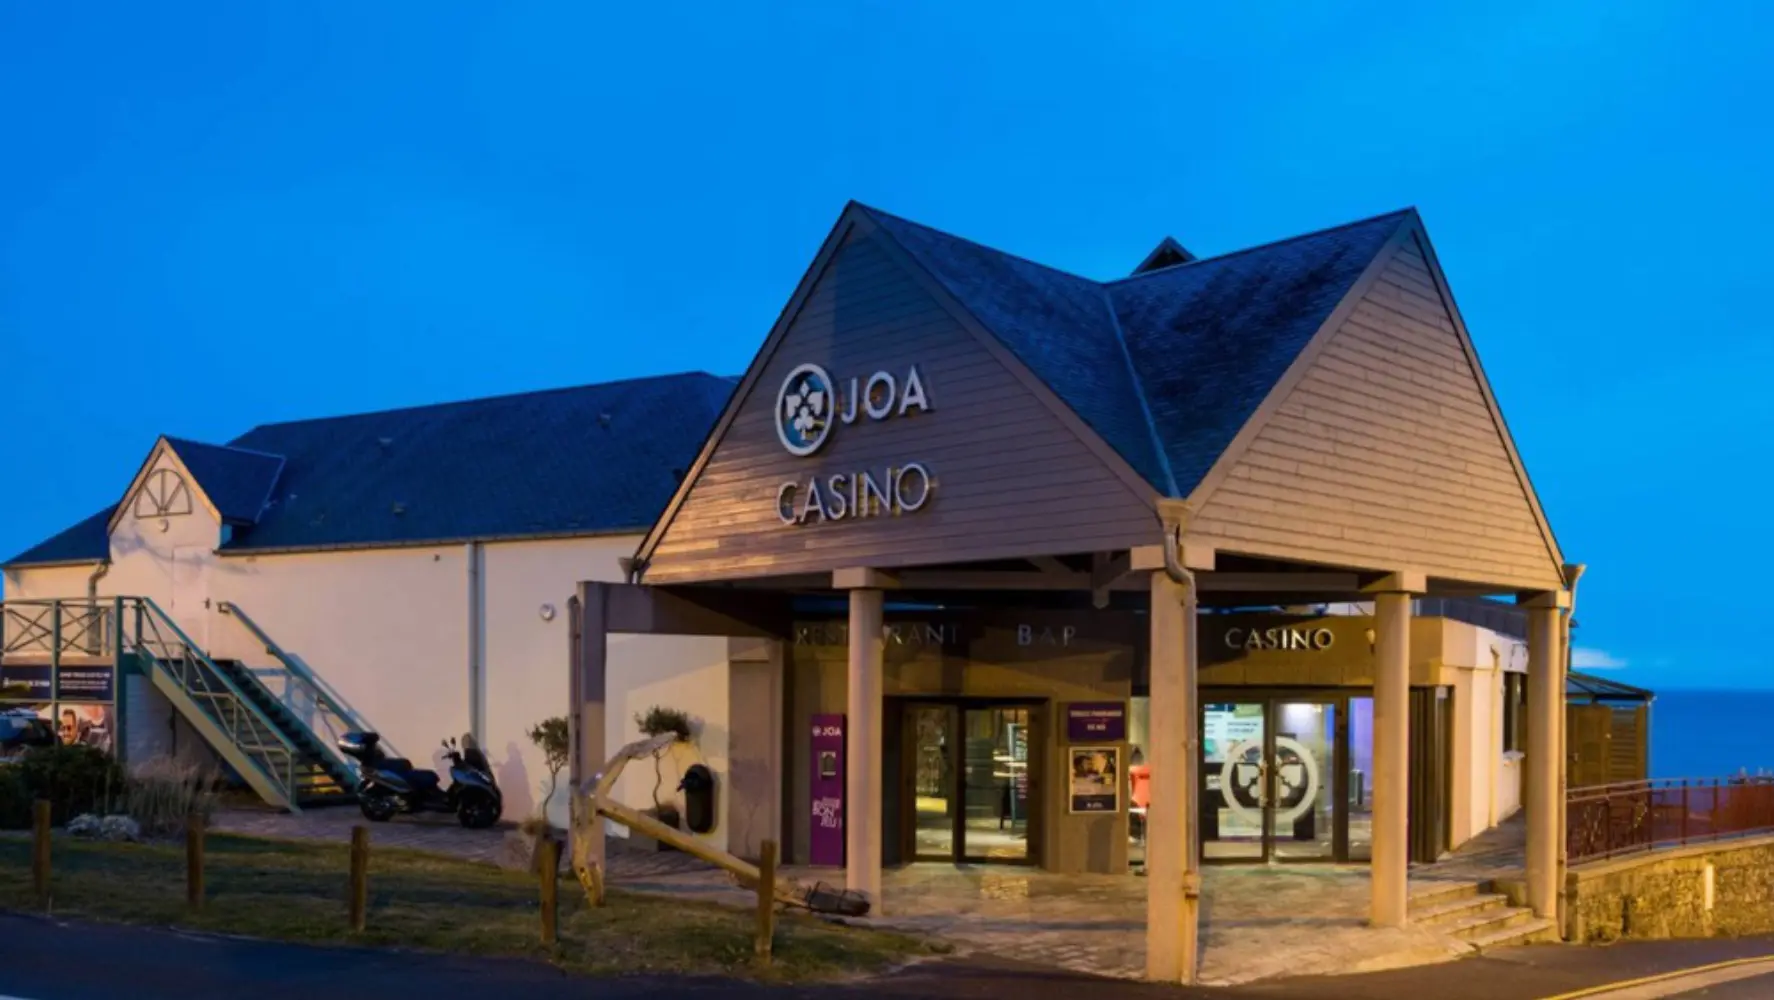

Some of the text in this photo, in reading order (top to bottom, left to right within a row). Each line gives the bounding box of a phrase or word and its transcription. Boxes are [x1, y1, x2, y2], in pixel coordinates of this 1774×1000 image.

[841, 365, 929, 424] JOA
[777, 463, 931, 526] CASINO
[1224, 627, 1335, 650] CASINO
